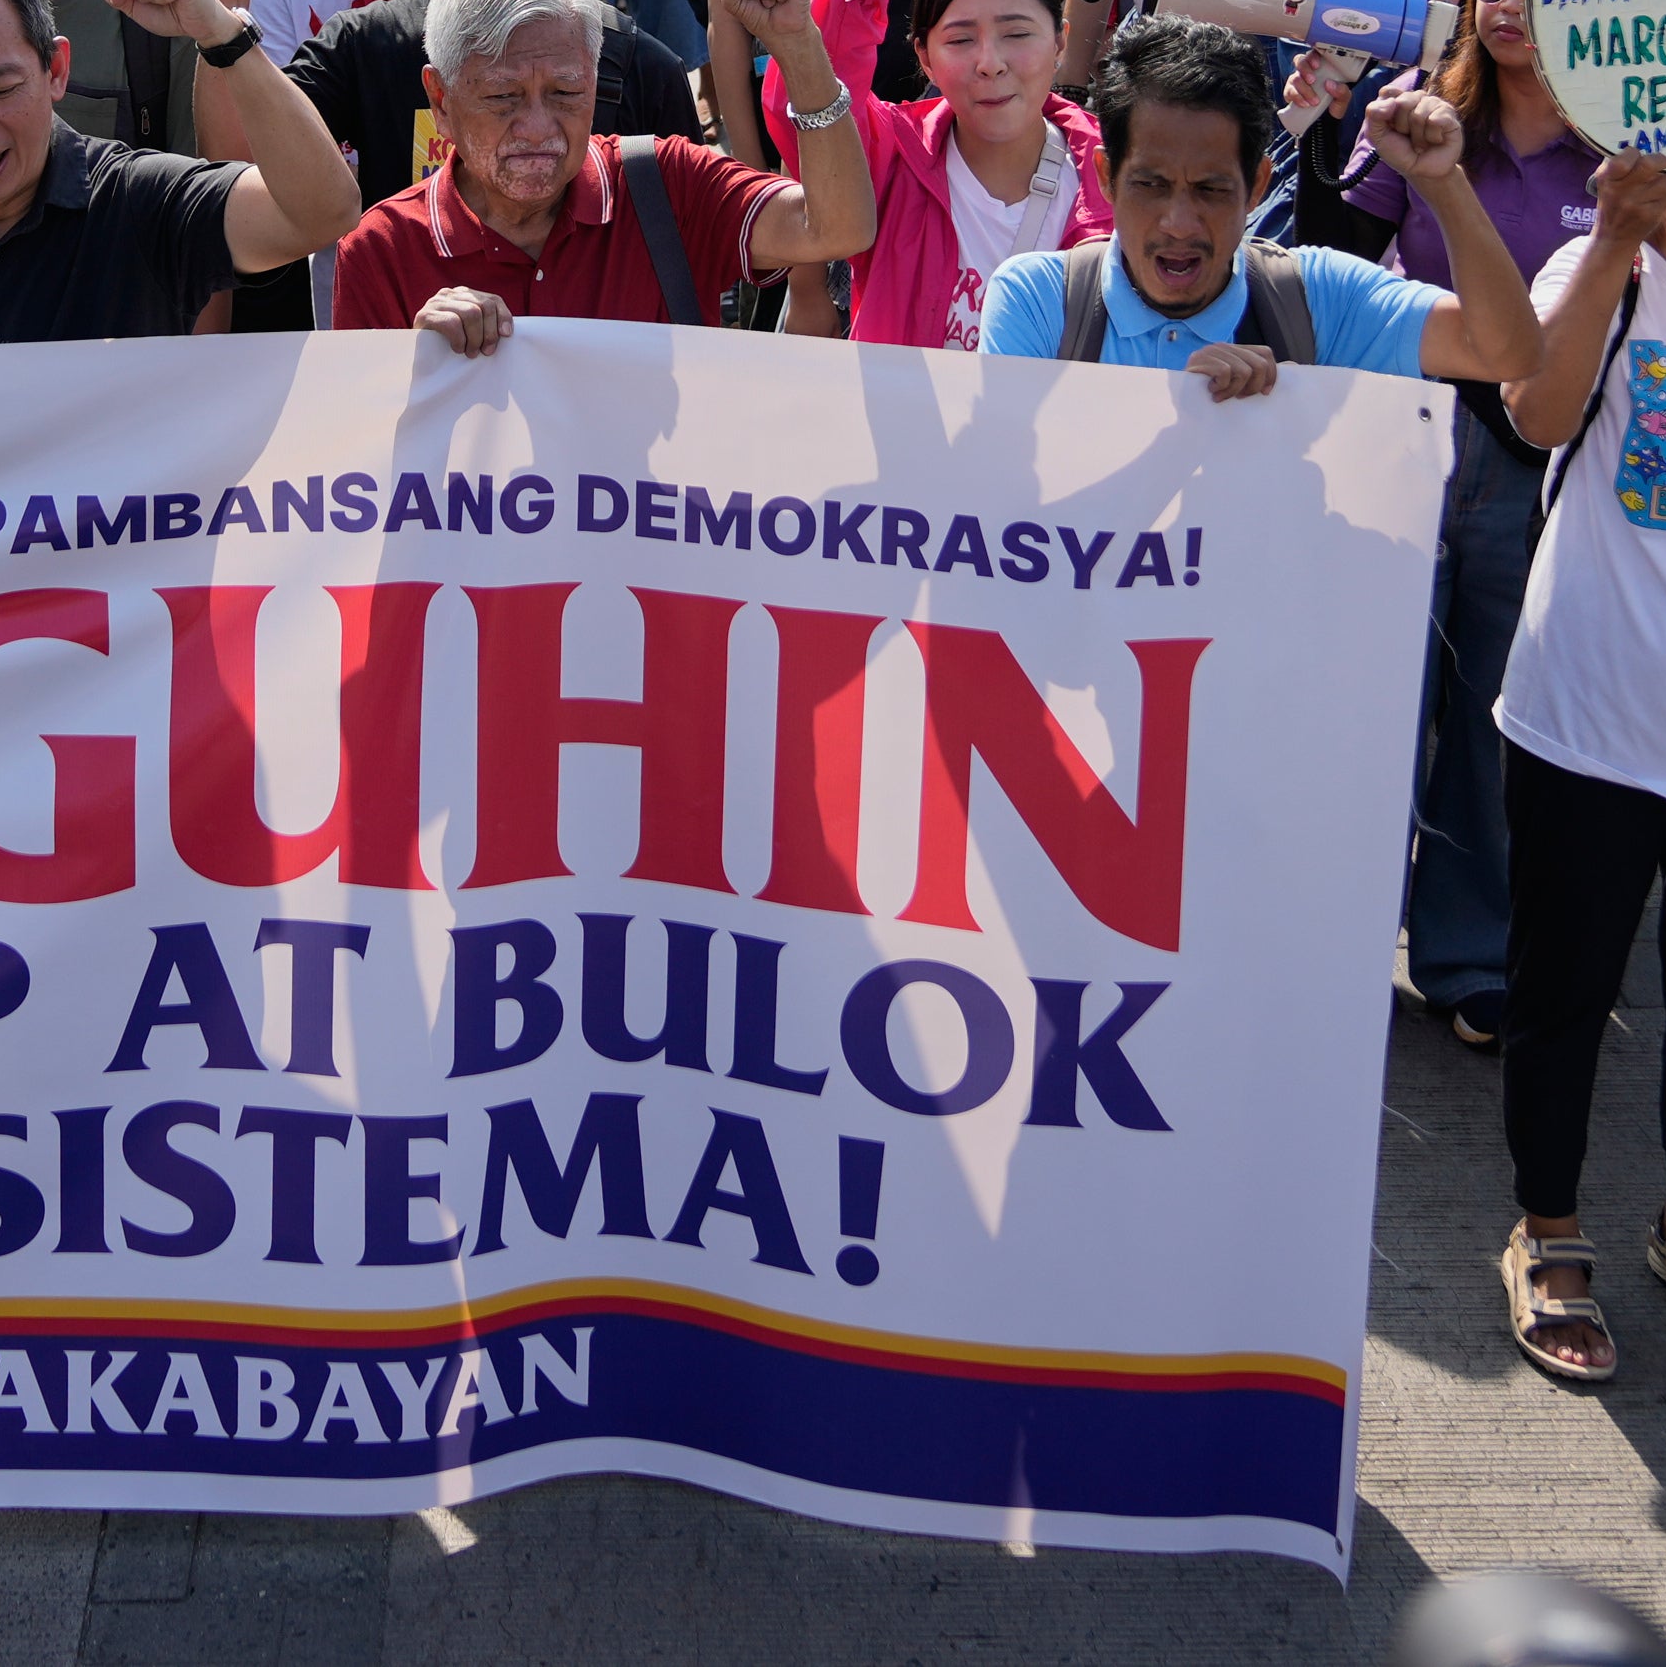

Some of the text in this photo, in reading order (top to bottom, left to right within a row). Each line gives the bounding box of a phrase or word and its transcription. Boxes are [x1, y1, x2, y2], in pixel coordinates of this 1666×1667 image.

[575, 472, 1206, 591] DEMOKRASYA!
[104, 920, 373, 1081] AT
[450, 911, 1176, 1133] BULOK
